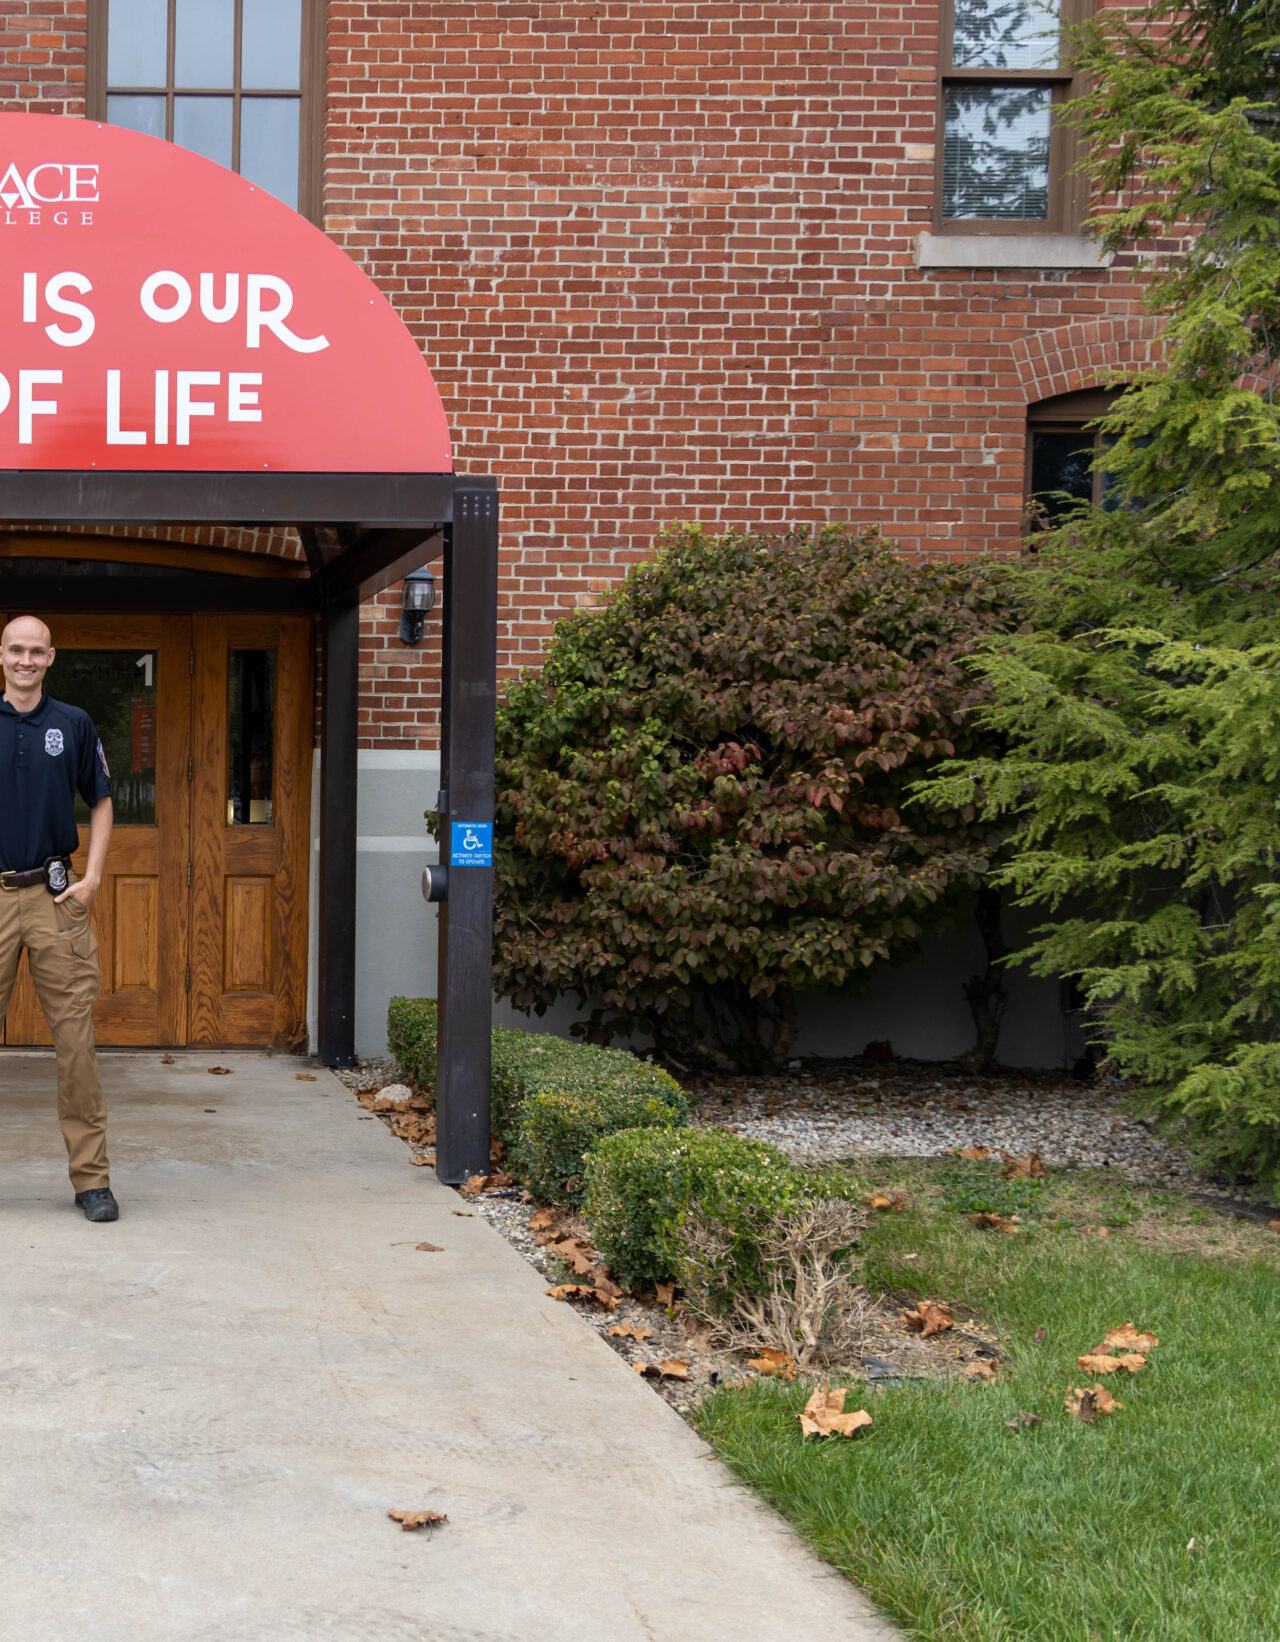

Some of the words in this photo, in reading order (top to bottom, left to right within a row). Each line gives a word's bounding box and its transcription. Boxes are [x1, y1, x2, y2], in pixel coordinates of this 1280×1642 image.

[23, 271, 96, 347] IS
[139, 270, 330, 354] OUR
[106, 369, 263, 446] LIFE
[136, 654, 152, 686] 1
